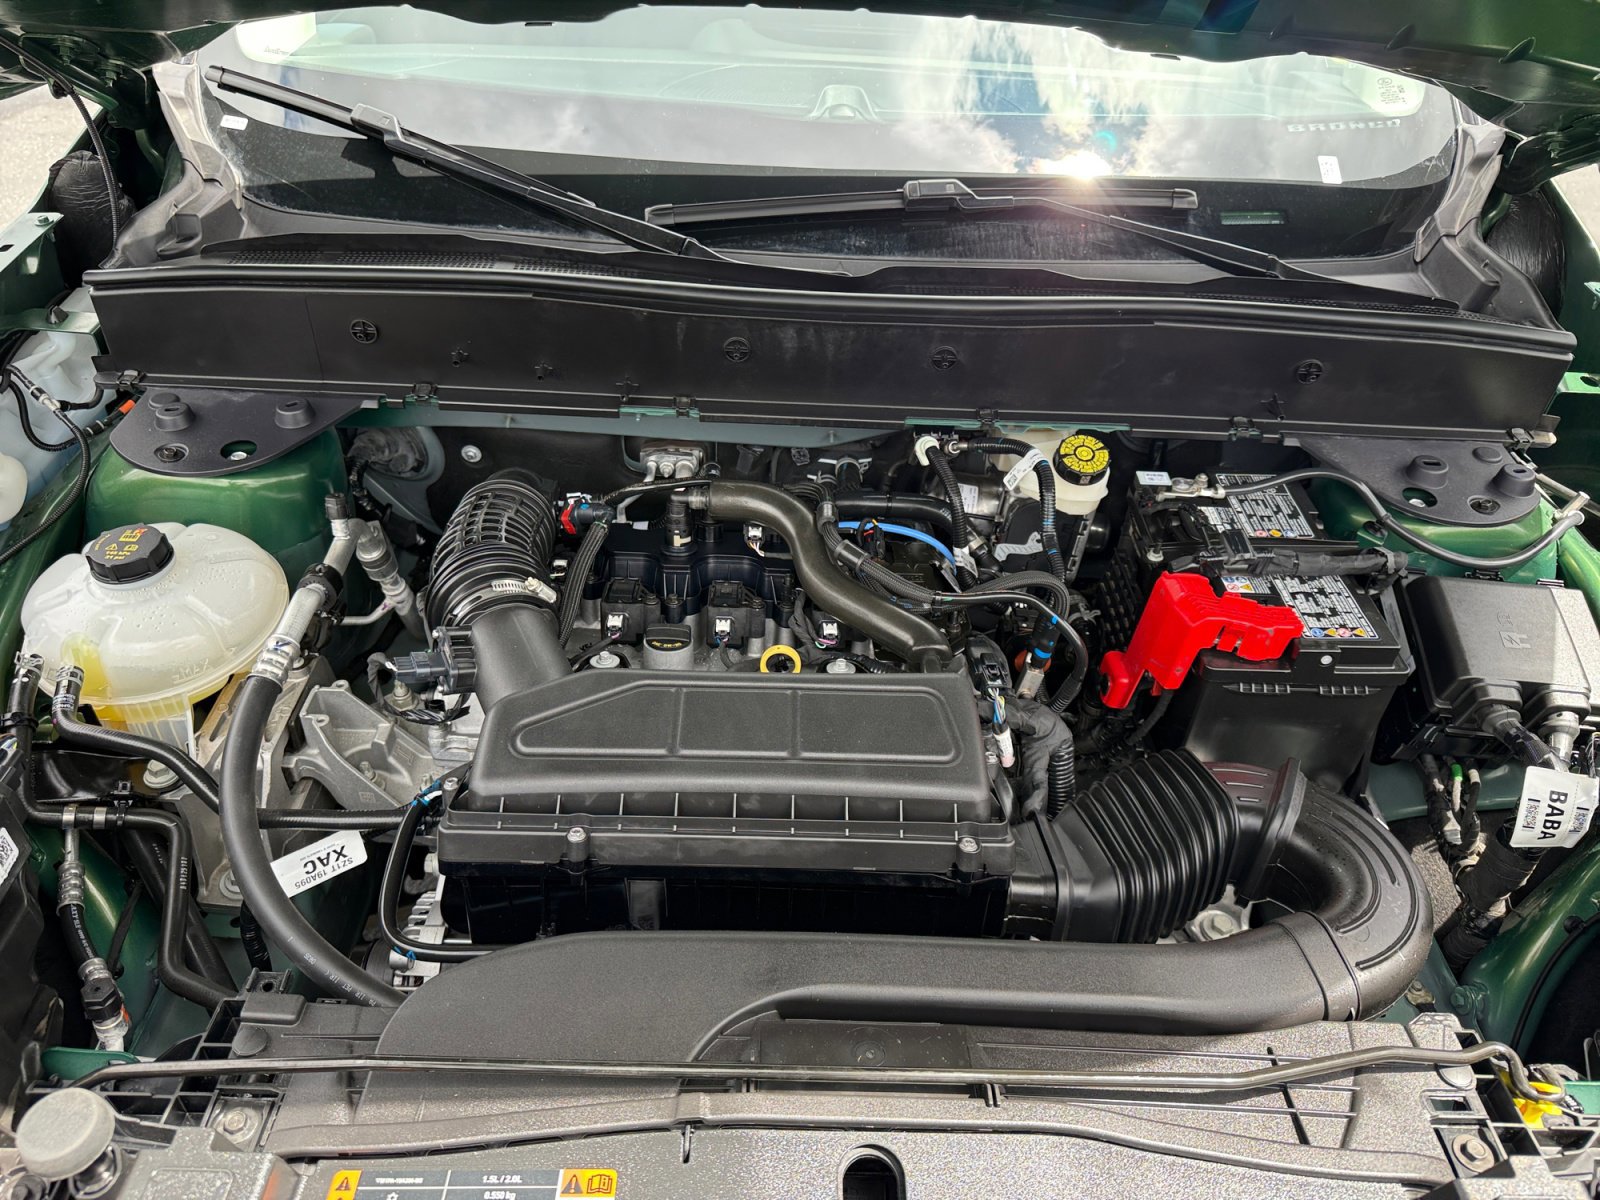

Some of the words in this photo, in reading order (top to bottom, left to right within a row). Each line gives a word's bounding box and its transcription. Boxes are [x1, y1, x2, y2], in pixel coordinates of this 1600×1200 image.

[1537, 790, 1568, 840] BABA
[303, 845, 348, 875] XAC
[331, 857, 354, 873] SZ1T
[294, 869, 327, 889] 19A095
